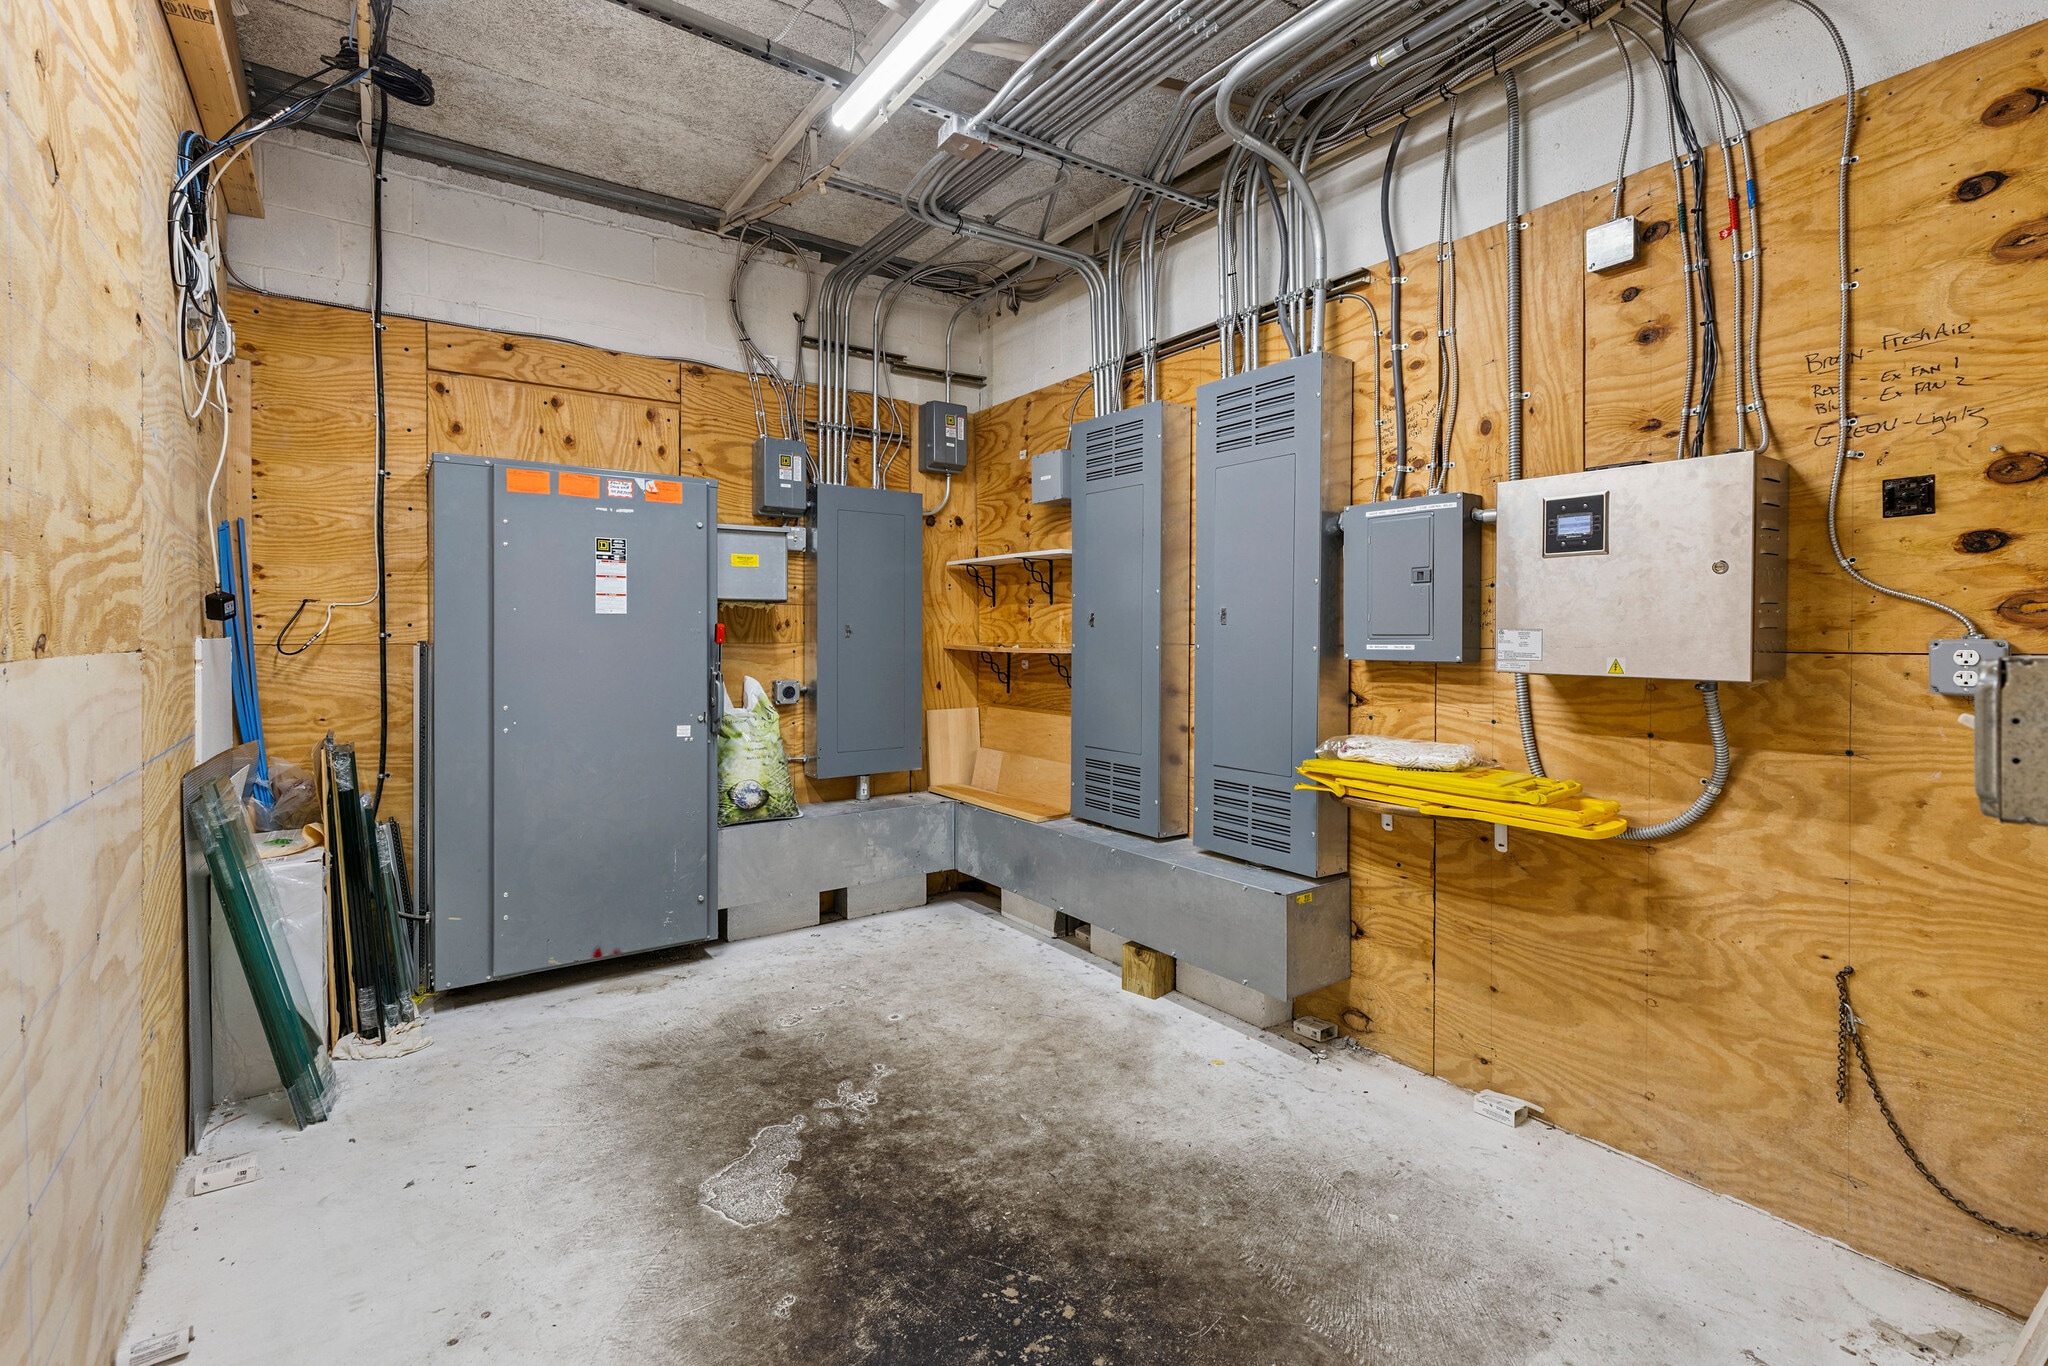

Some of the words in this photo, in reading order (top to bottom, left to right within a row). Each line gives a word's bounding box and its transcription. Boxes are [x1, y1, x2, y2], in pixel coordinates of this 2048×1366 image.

[1911, 364, 1942, 377] FAN
[1954, 356, 1959, 369] 1
[1914, 380, 1947, 395] FAN
[1956, 375, 1975, 386] 2
